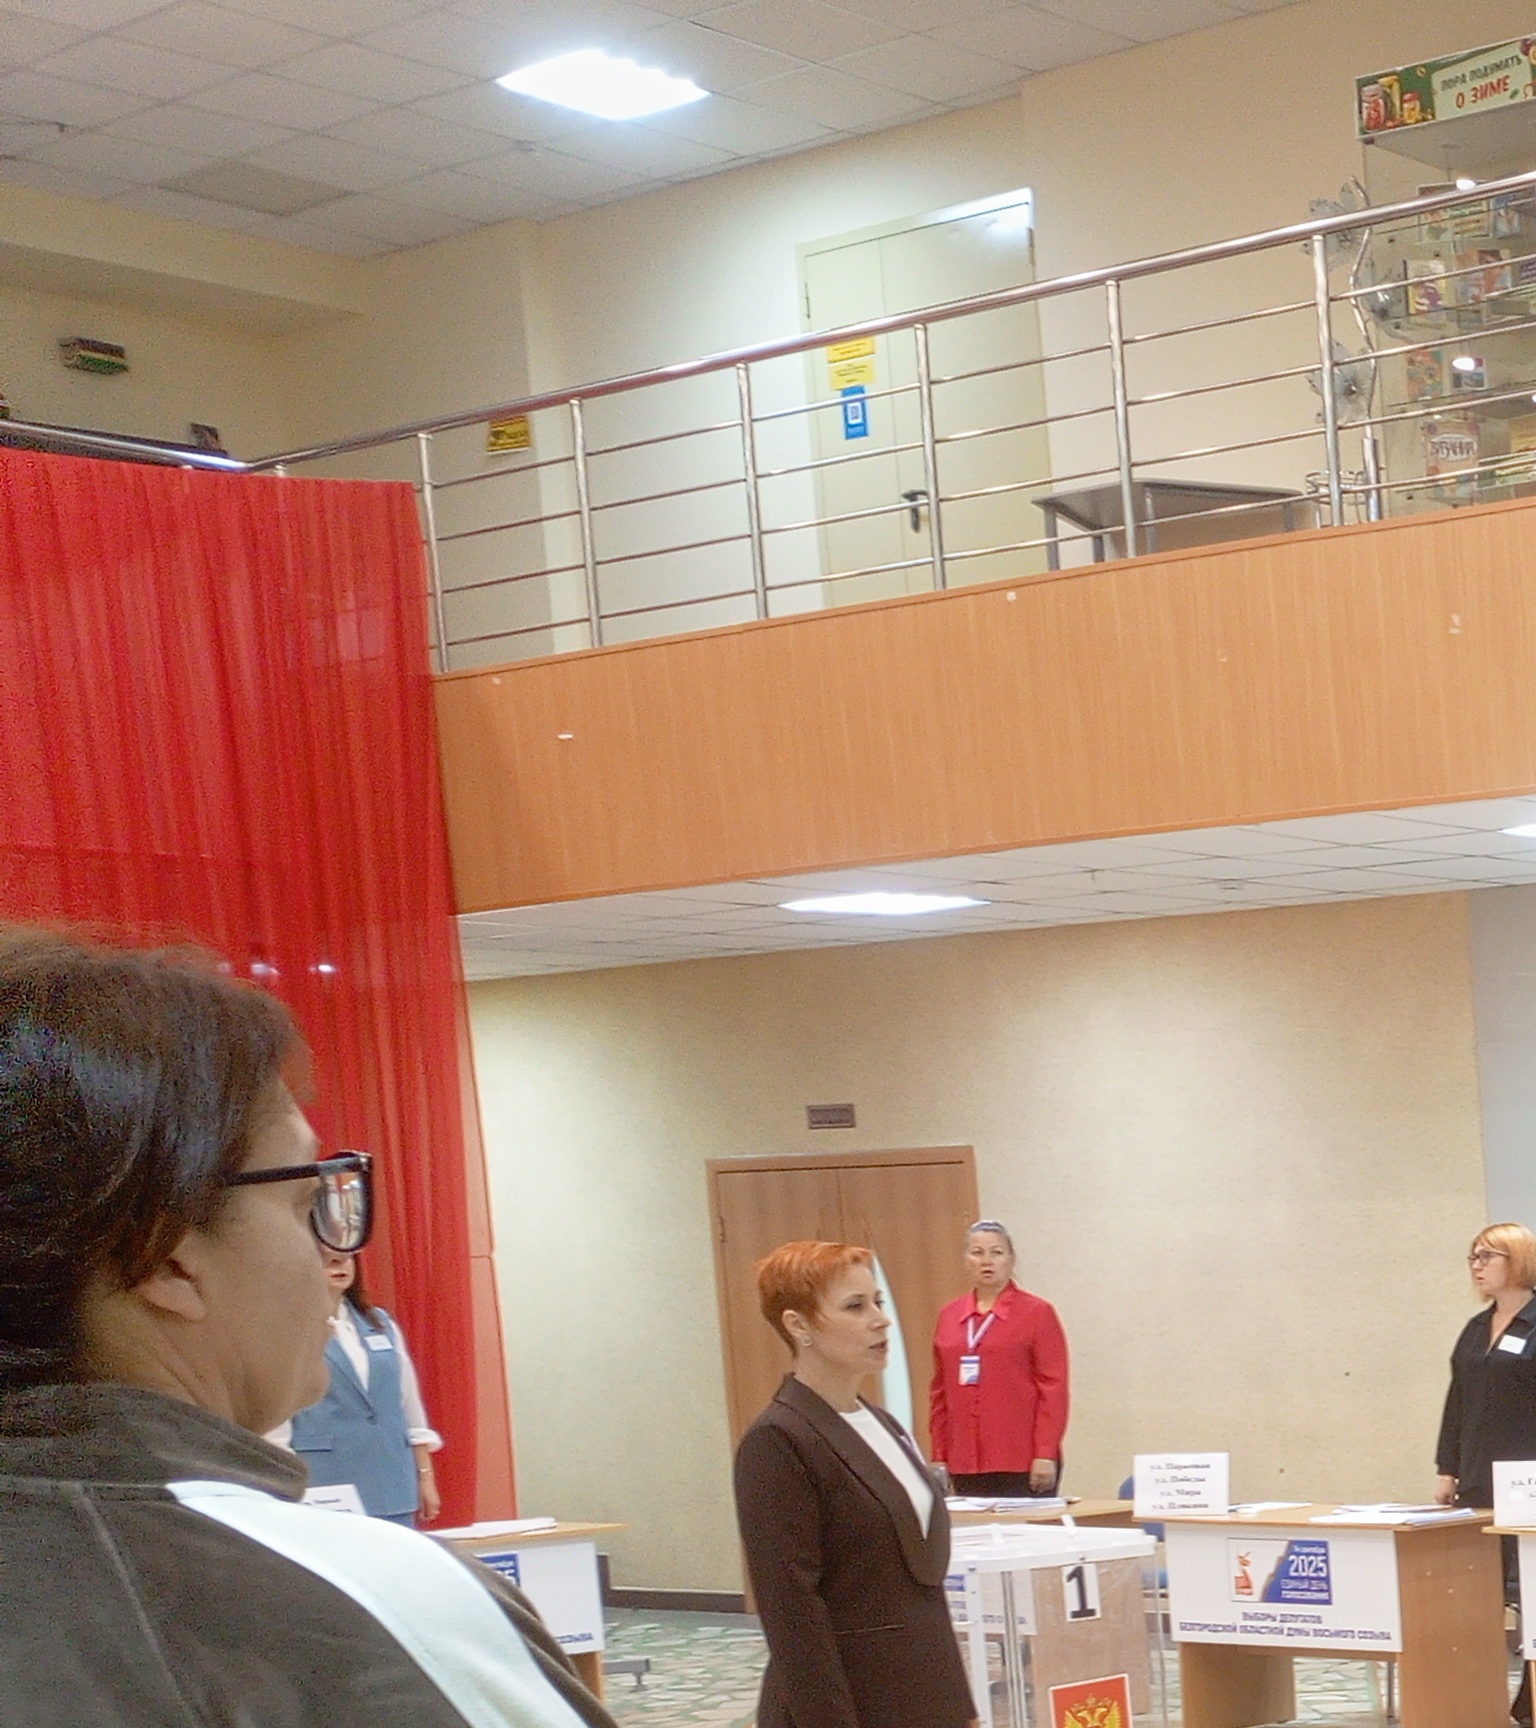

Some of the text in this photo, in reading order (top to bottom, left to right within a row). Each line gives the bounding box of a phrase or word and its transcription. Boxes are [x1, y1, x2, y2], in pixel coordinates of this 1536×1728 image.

[1455, 75, 1510, 108] О ЗИМЕ
[1288, 1555, 1328, 1578] 2025
[1065, 1565, 1097, 1619] 1
